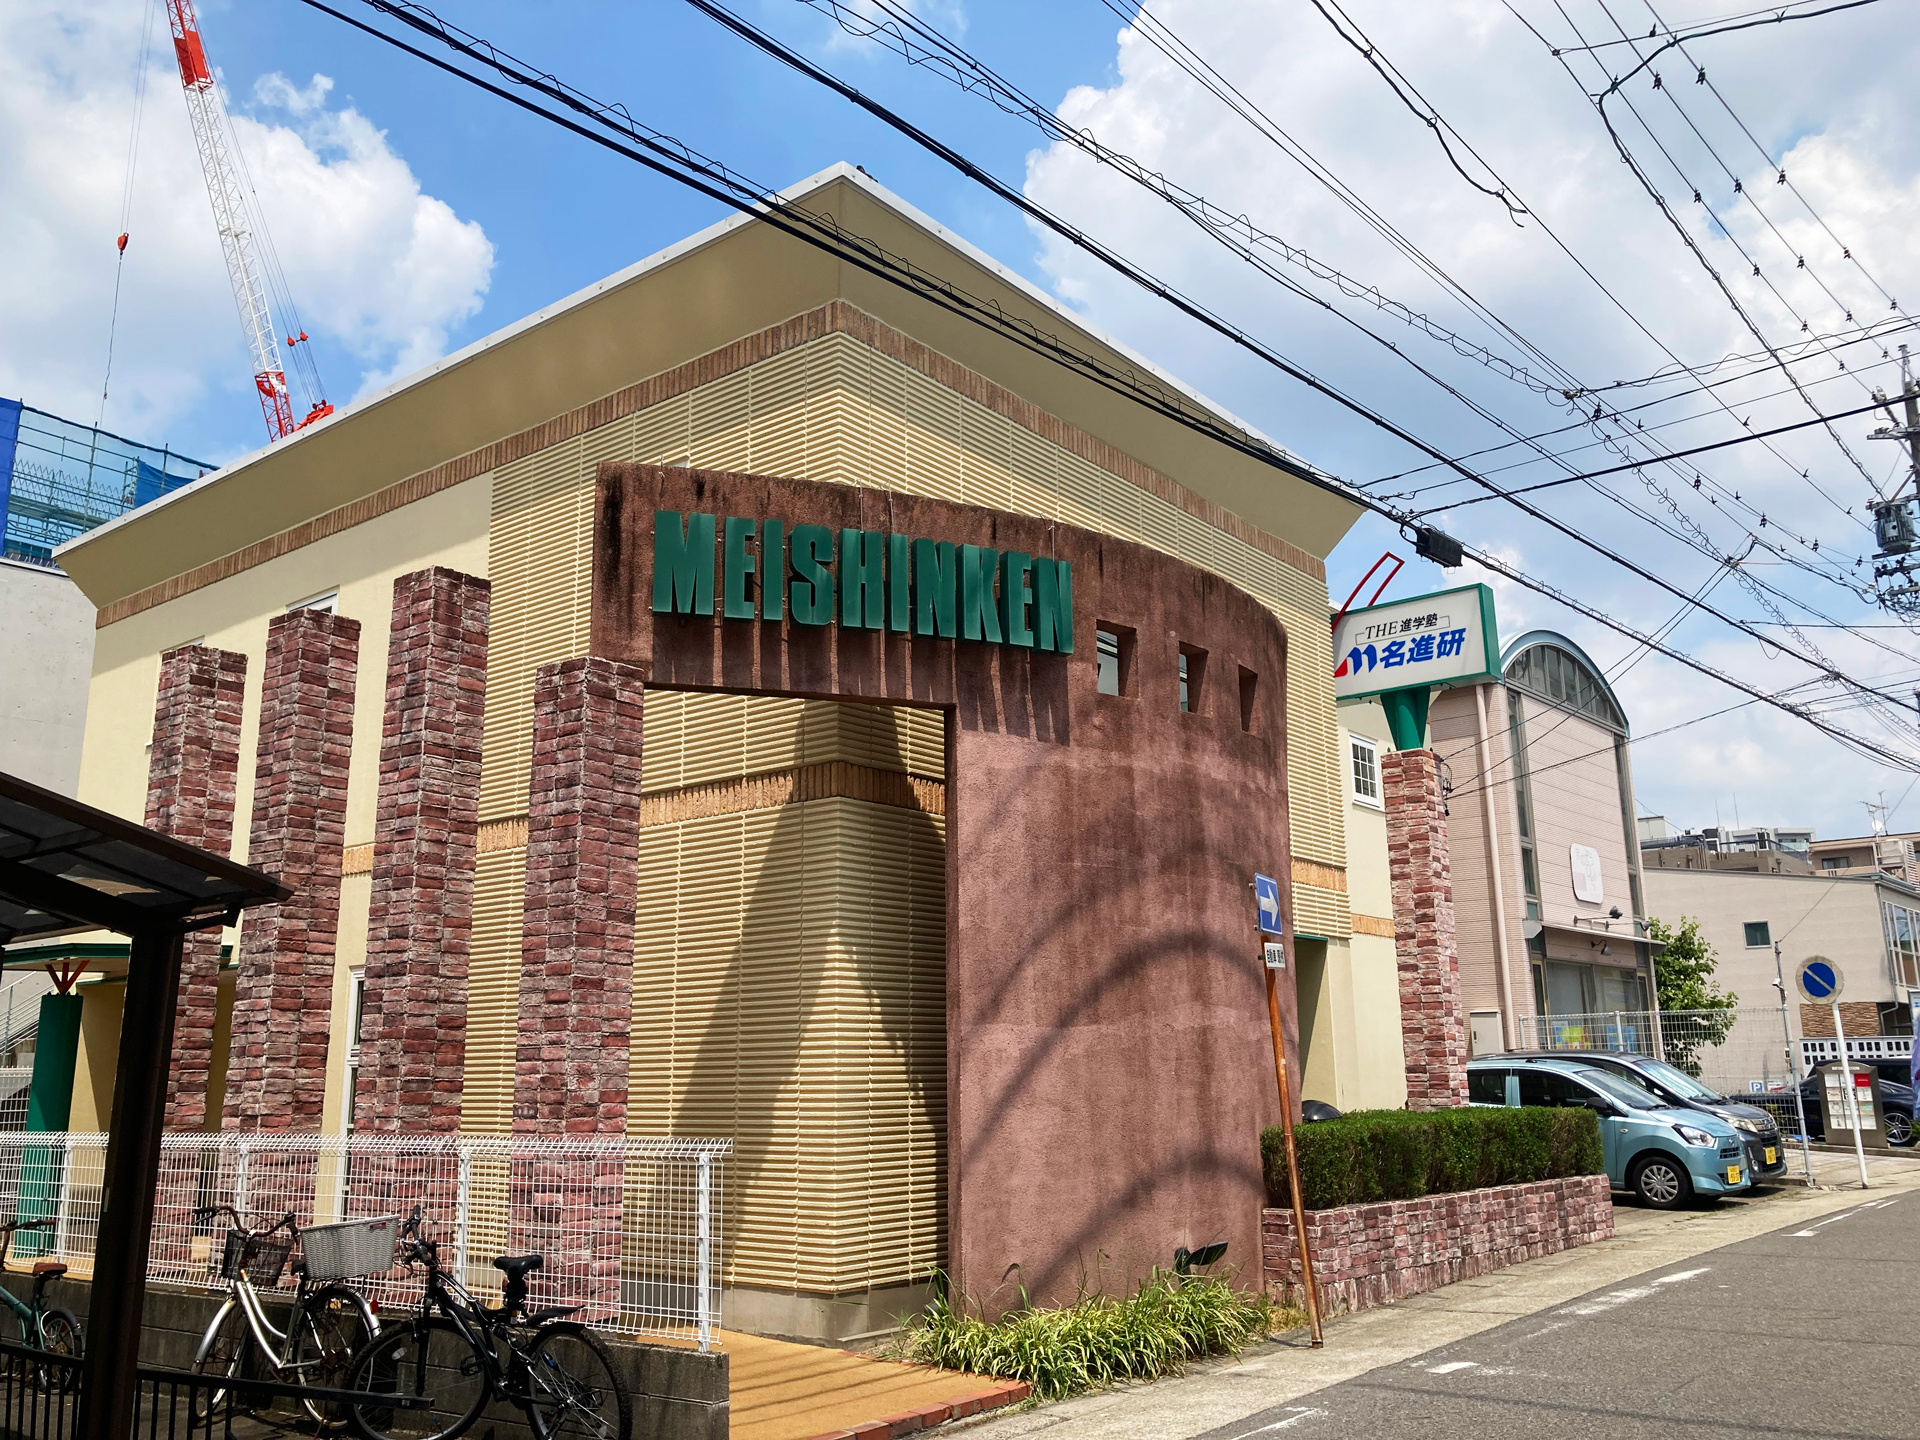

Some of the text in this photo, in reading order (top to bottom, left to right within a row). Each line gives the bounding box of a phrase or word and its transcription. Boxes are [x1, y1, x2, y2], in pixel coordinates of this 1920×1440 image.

[652, 510, 1074, 656] MEISHINKEN
[1366, 613, 1438, 639] THE 進学塾
[1380, 628, 1466, 668] 名進研
